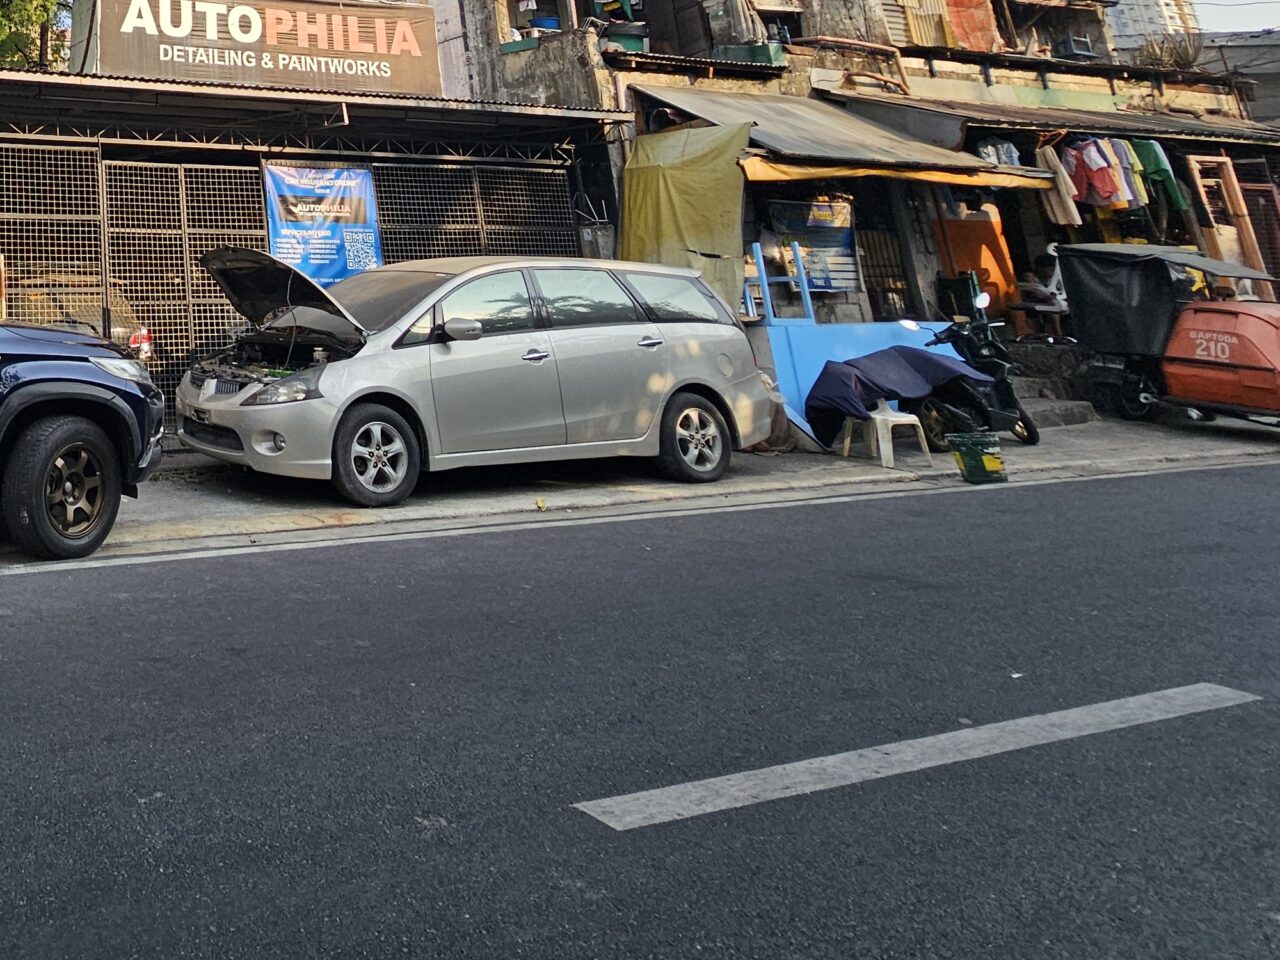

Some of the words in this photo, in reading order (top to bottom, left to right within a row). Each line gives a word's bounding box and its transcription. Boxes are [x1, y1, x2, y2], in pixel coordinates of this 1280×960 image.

[159, 44, 256, 68] DETAILING
[260, 53, 274, 69] &
[278, 54, 392, 78] PAINTWORKS
[297, 204, 351, 212] AUTOPHILIA
[1195, 339, 1230, 358] 210
